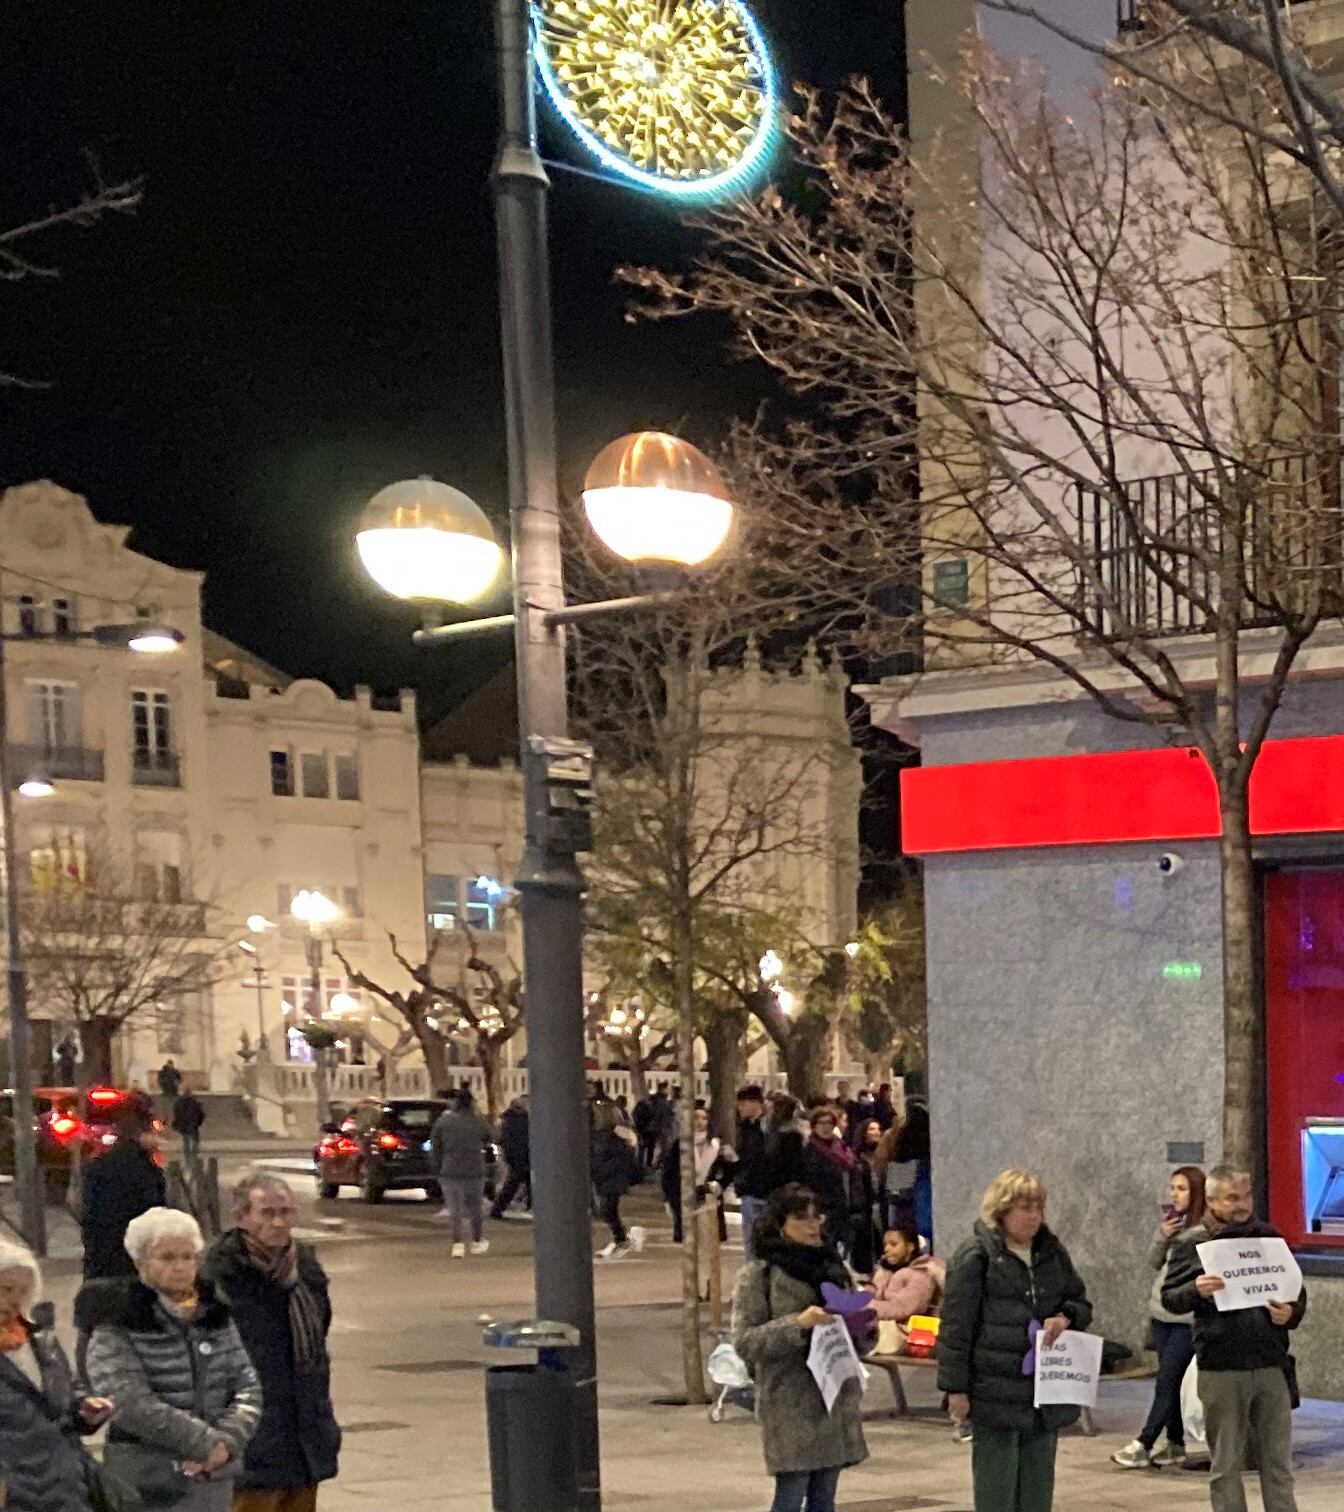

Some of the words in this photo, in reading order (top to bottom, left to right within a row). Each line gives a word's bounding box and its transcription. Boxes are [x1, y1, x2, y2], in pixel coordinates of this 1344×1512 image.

[1238, 1250, 1262, 1259] NOS
[1223, 1264, 1287, 1279] QUEREMOS
[1243, 1283, 1279, 1295] VIVAS
